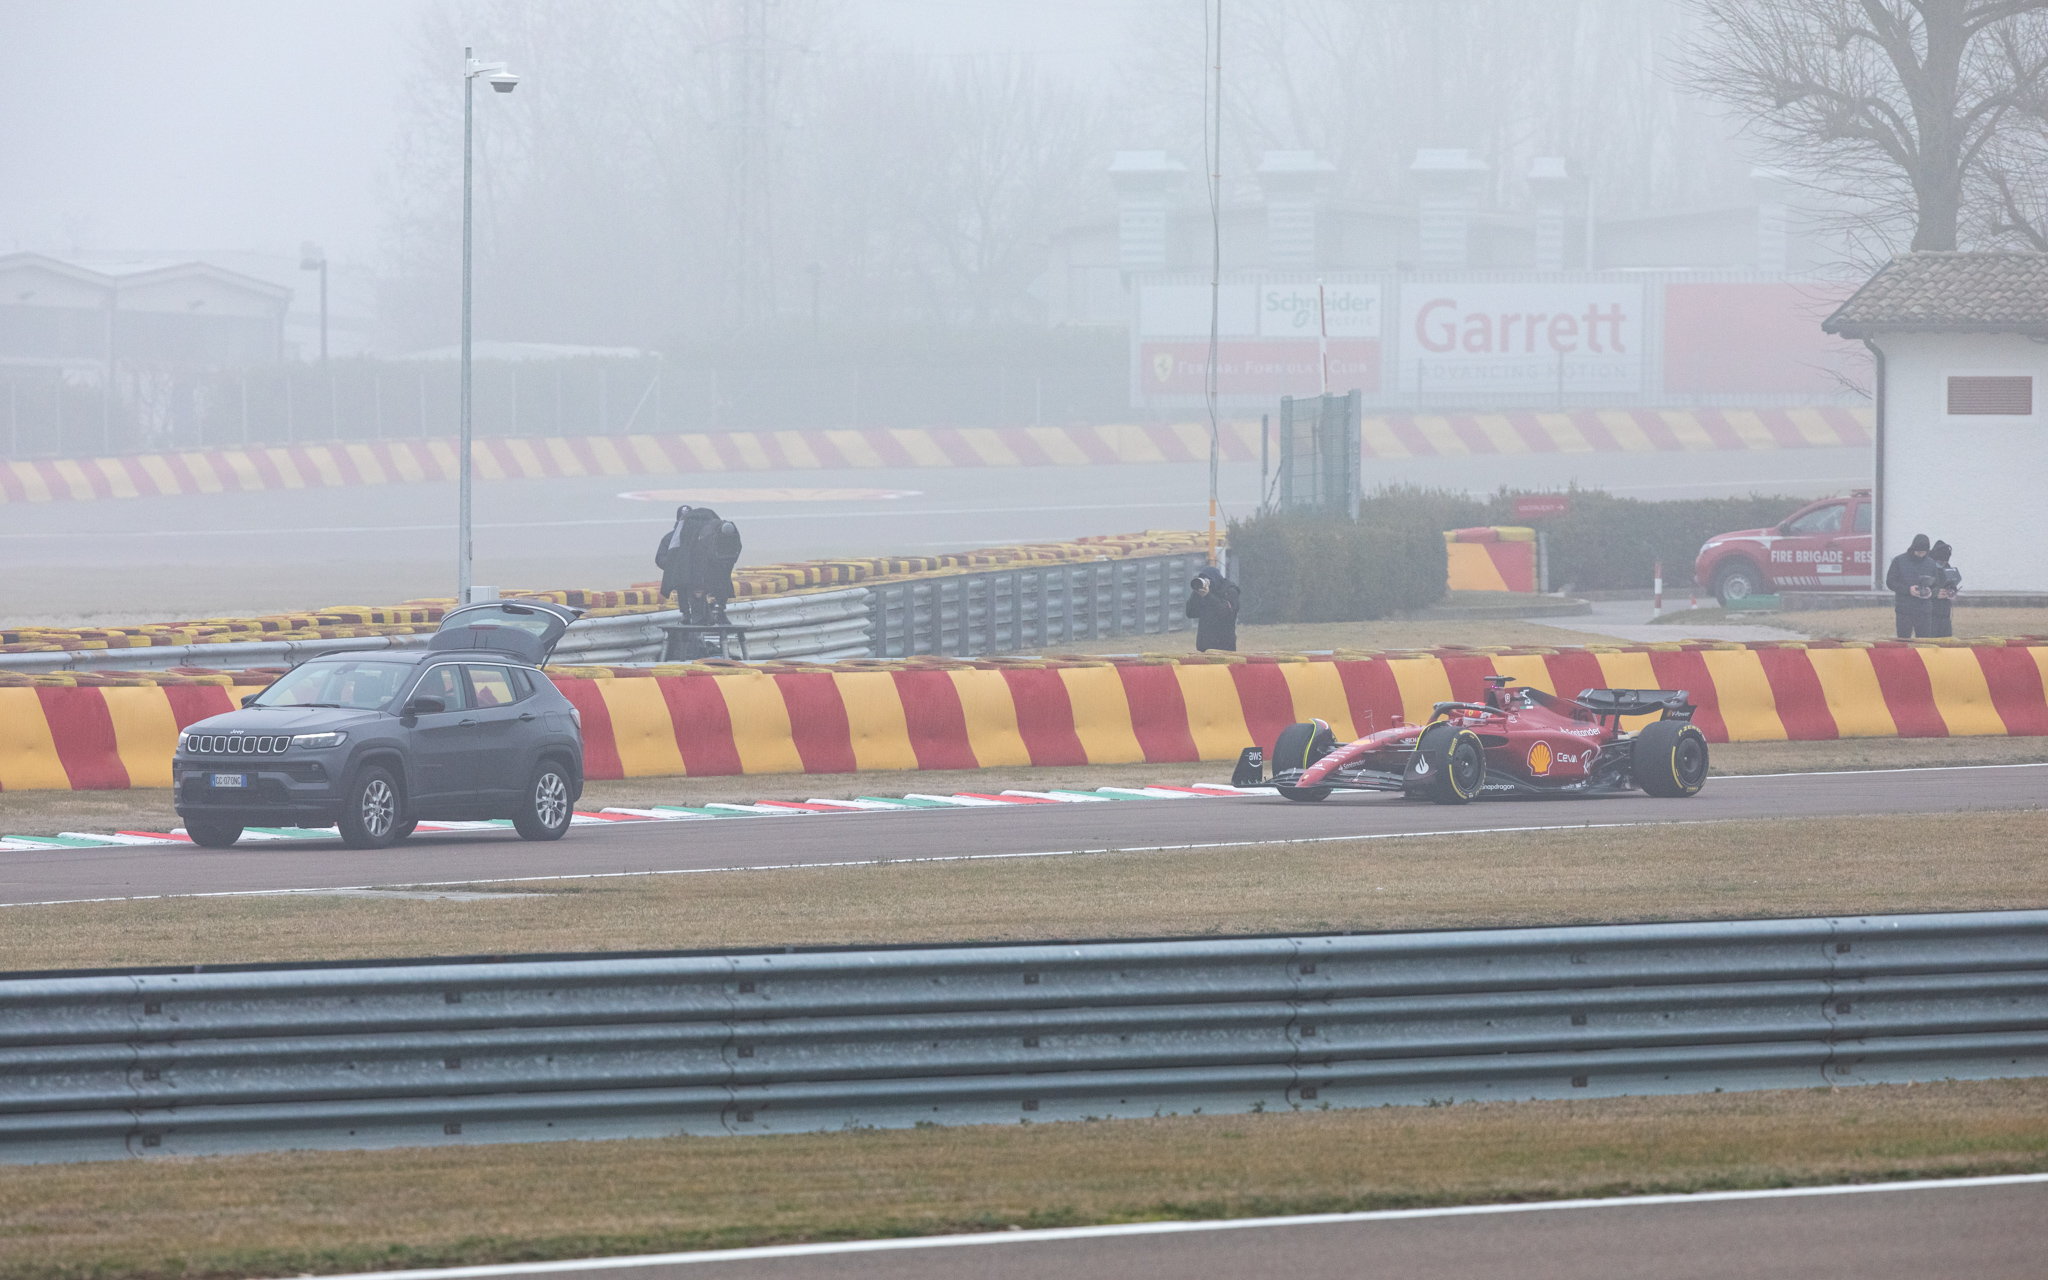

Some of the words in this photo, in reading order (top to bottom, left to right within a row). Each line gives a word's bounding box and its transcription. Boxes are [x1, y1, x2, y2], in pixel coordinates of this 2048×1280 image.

[1265, 291, 1375, 312] Schneider
[1415, 298, 1627, 353] Garrett
[1771, 551, 1792, 562] FIRE
[1796, 550, 1843, 562] BRIGADE
[1854, 551, 1872, 562] RES
[1249, 751, 1263, 761] aws
